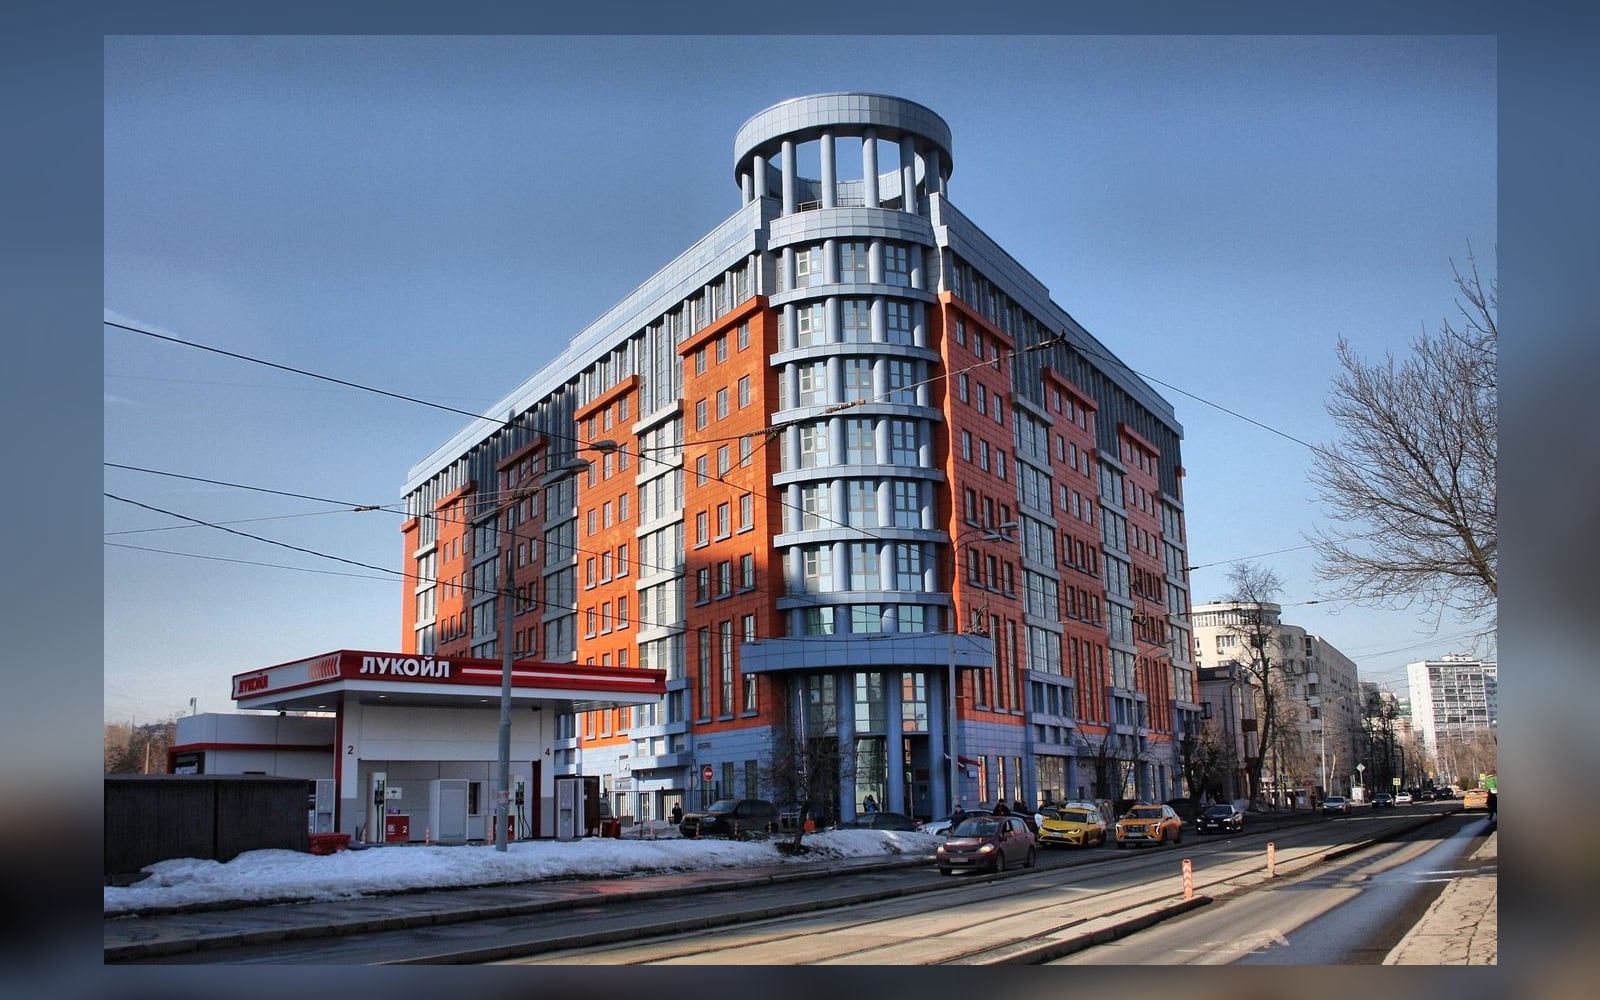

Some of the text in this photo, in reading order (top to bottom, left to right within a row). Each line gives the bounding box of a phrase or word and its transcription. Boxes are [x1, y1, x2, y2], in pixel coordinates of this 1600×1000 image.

[360, 656, 449, 678] ЛУКОЙЛ
[347, 745, 354, 754] 2
[545, 748, 550, 756] 4
[402, 825, 408, 833] 2
